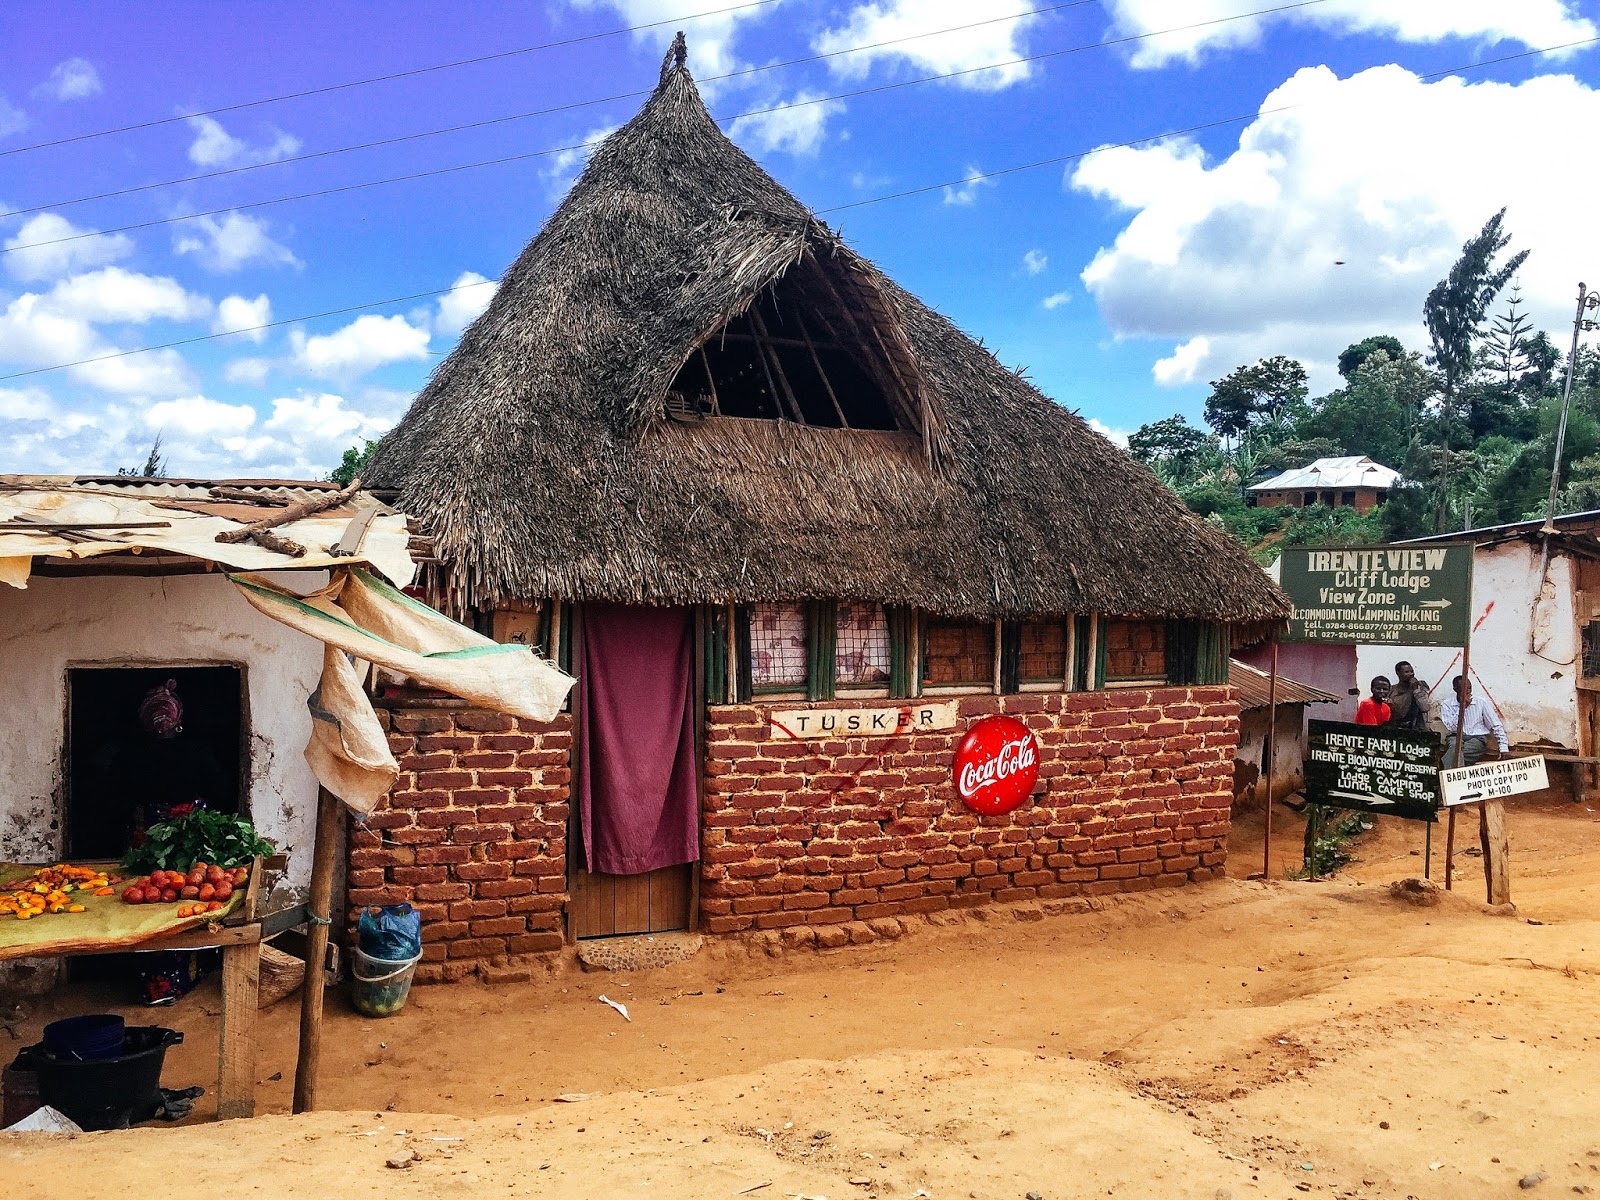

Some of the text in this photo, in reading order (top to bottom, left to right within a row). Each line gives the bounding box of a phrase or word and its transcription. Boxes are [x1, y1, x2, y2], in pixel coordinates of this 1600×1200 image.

[1308, 549, 1448, 572] IRENTE VIEW
[1320, 588, 1396, 605] View Zone
[1358, 604, 1401, 622] CAMPING
[1401, 604, 1440, 622] HIKING
[1304, 629, 1318, 638] Tel
[796, 709, 934, 732] TUSKER
[1325, 733, 1365, 748] IRENTE
[959, 733, 1036, 797] Coca-Cola
[1311, 749, 1437, 775] IRENTE BIODIVERSITY RESERVE
[1446, 770, 1467, 782] BABU
[1496, 758, 1541, 774] STATIONARY
[1341, 771, 1370, 783] Lodge
[1467, 779, 1491, 790] PHOTO
[1493, 775, 1513, 786] COPY
[1378, 785, 1404, 797] CAKE
